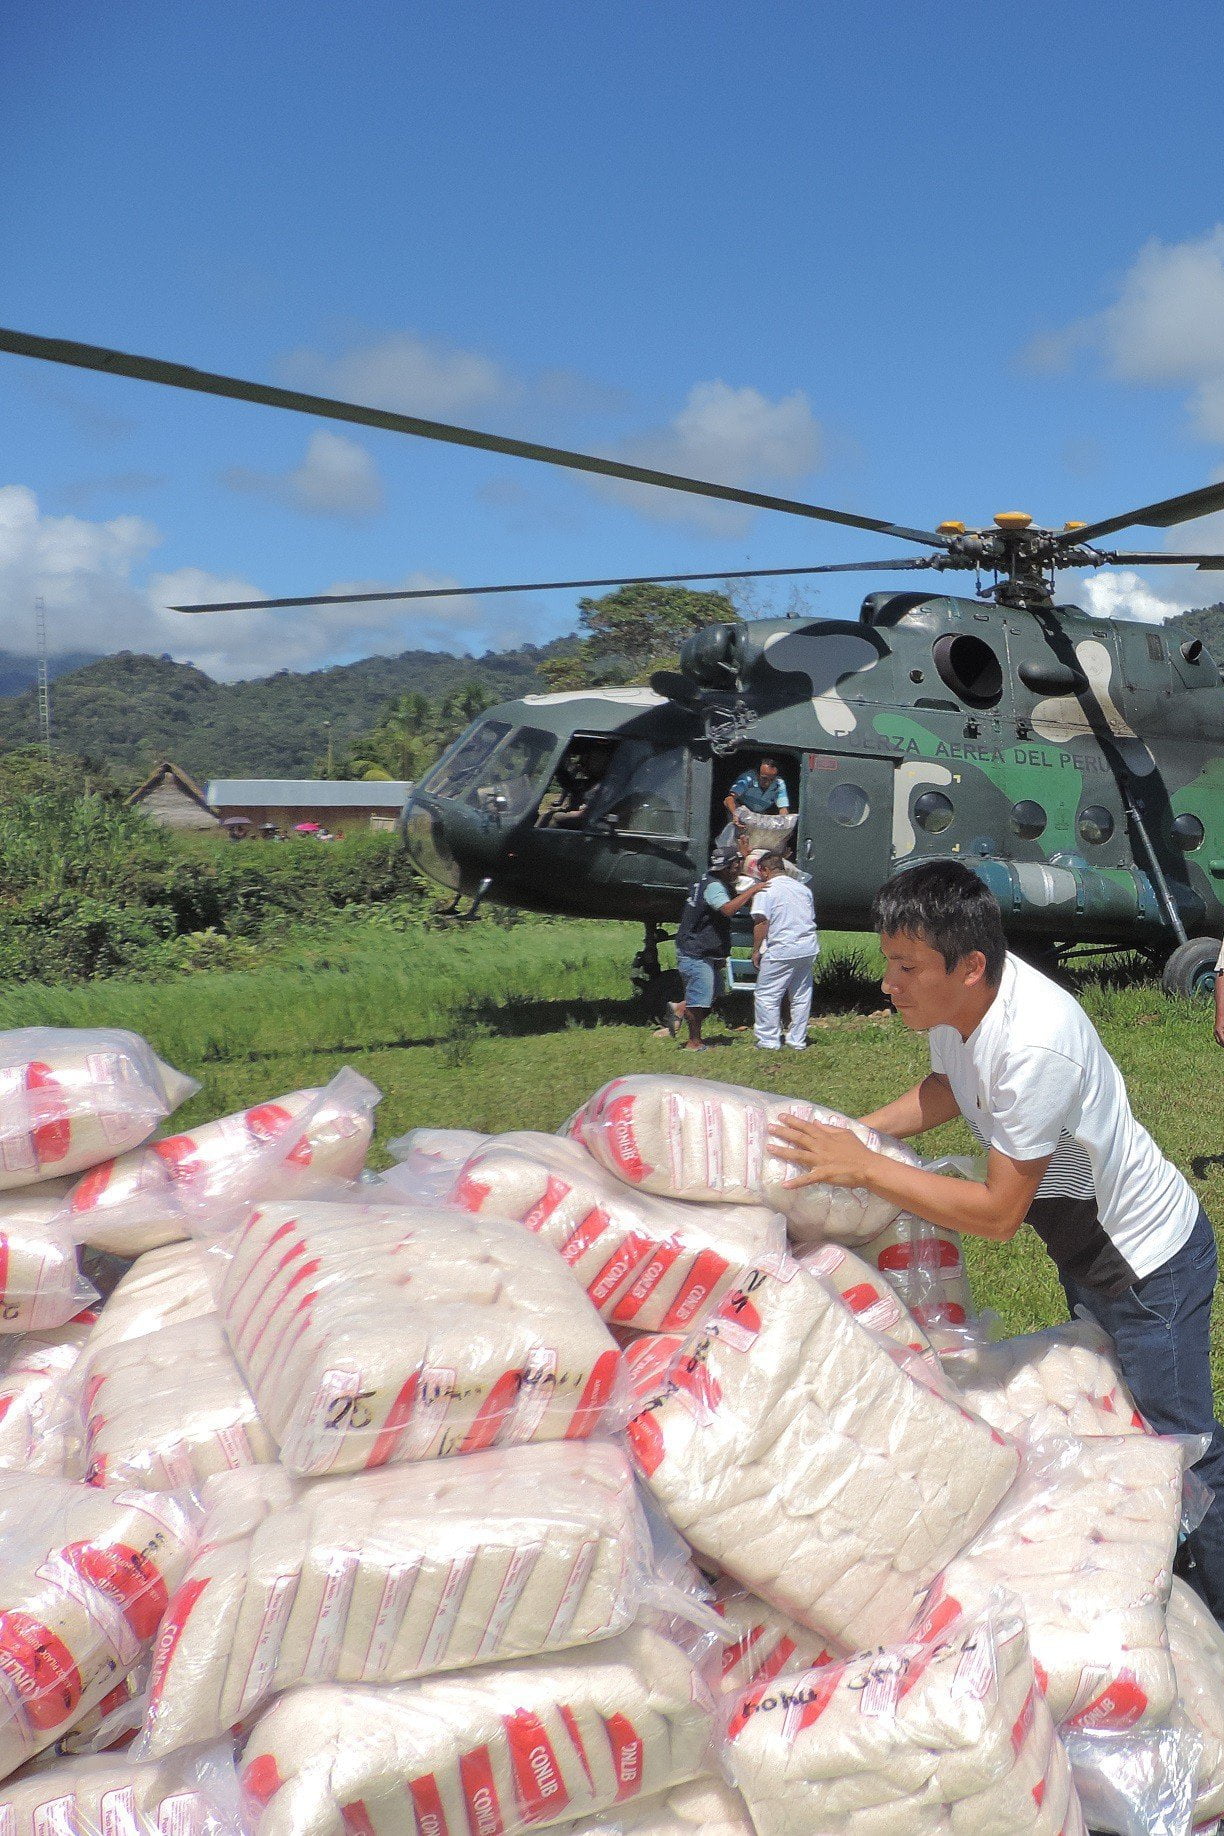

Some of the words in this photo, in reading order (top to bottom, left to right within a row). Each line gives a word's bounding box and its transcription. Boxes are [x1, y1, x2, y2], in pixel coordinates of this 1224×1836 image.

[935, 741, 1006, 764] AEREA
[1014, 748, 1053, 768] DEL
[631, 1261, 664, 1299] CONLIB
[675, 1284, 707, 1320] CONLIB
[528, 1745, 559, 1798] CONLIB
[472, 1787, 497, 1836] CONLIB
